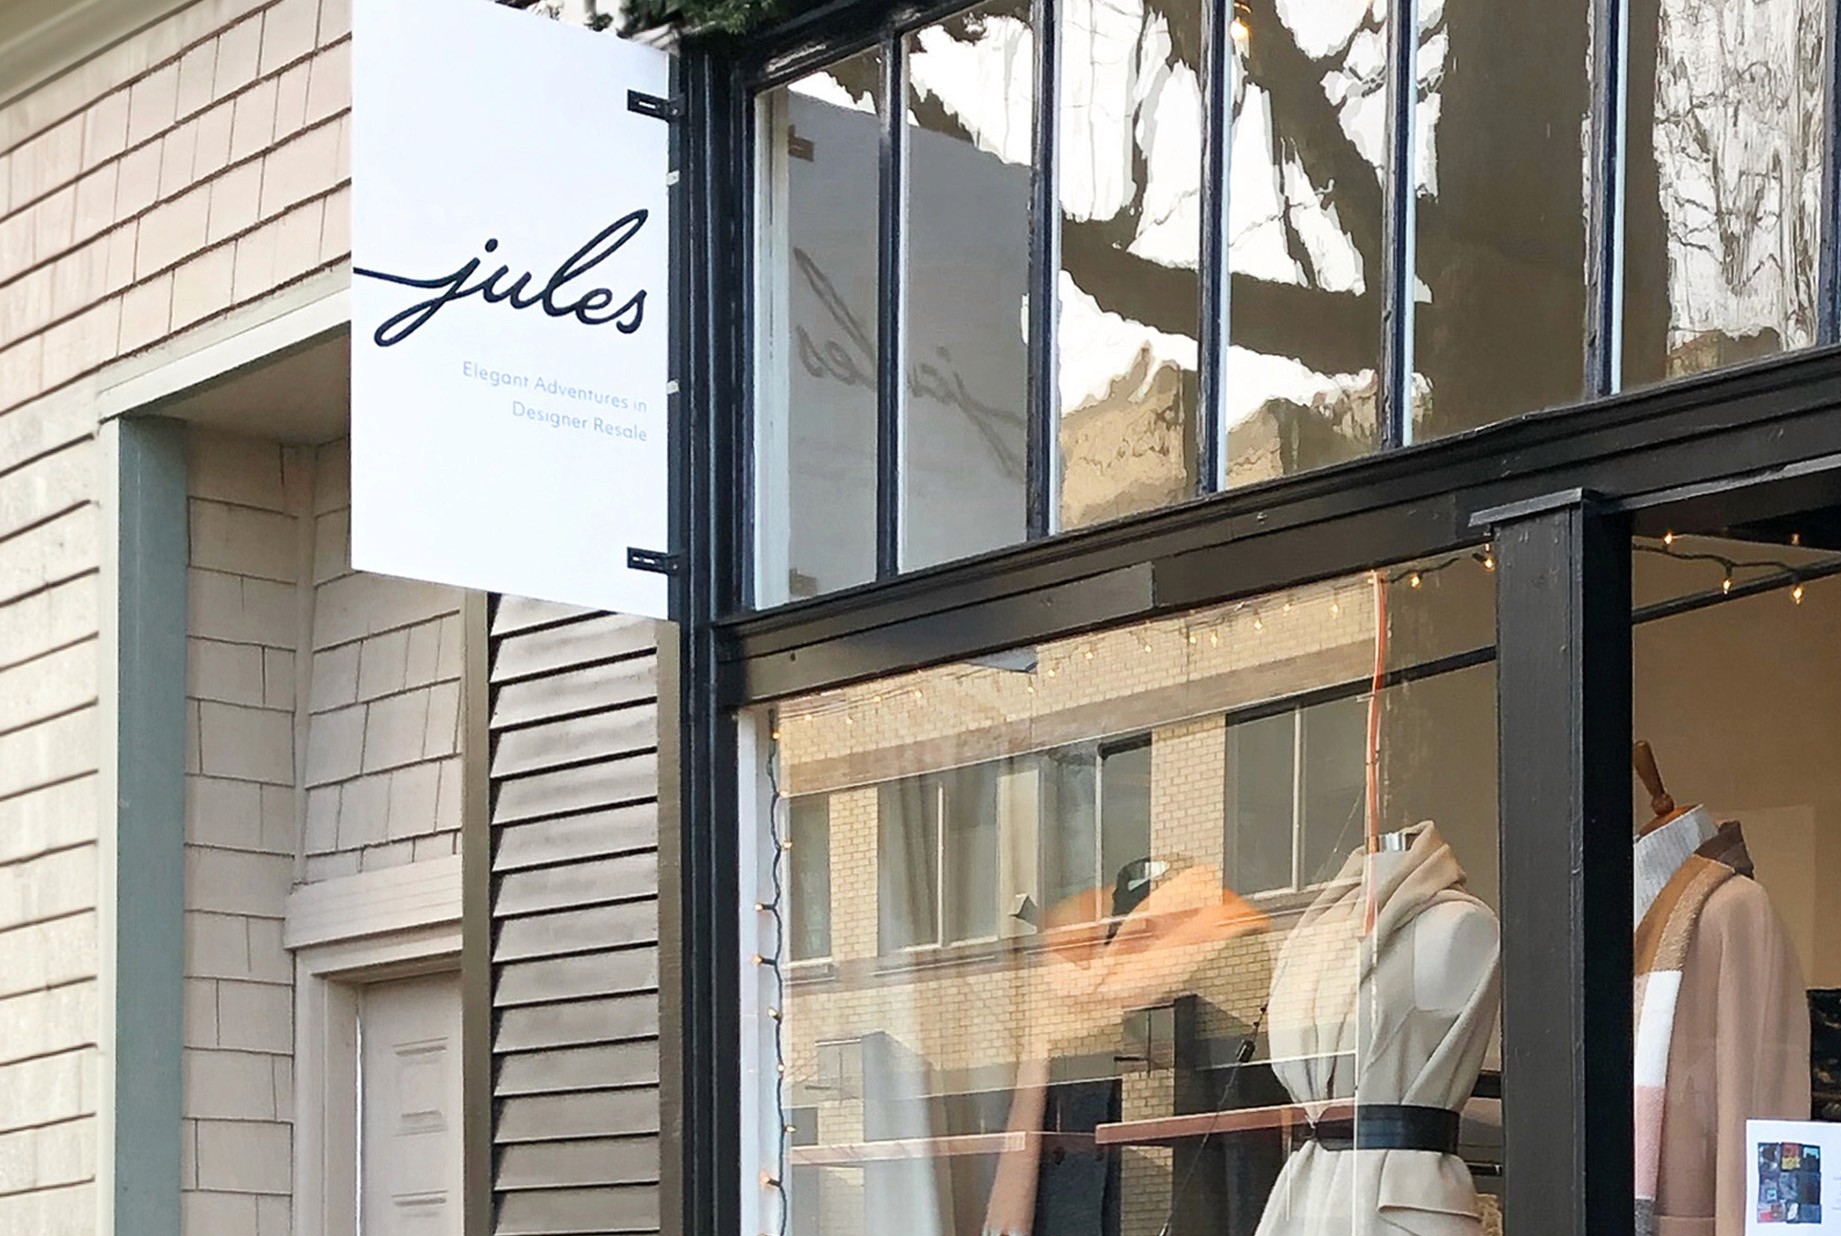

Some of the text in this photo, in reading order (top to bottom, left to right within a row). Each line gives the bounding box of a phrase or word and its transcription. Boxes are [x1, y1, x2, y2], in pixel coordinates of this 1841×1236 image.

[352, 208, 649, 348] jules
[462, 360, 648, 413] Elegant Adventures in
[512, 400, 648, 442] Designer Resale
